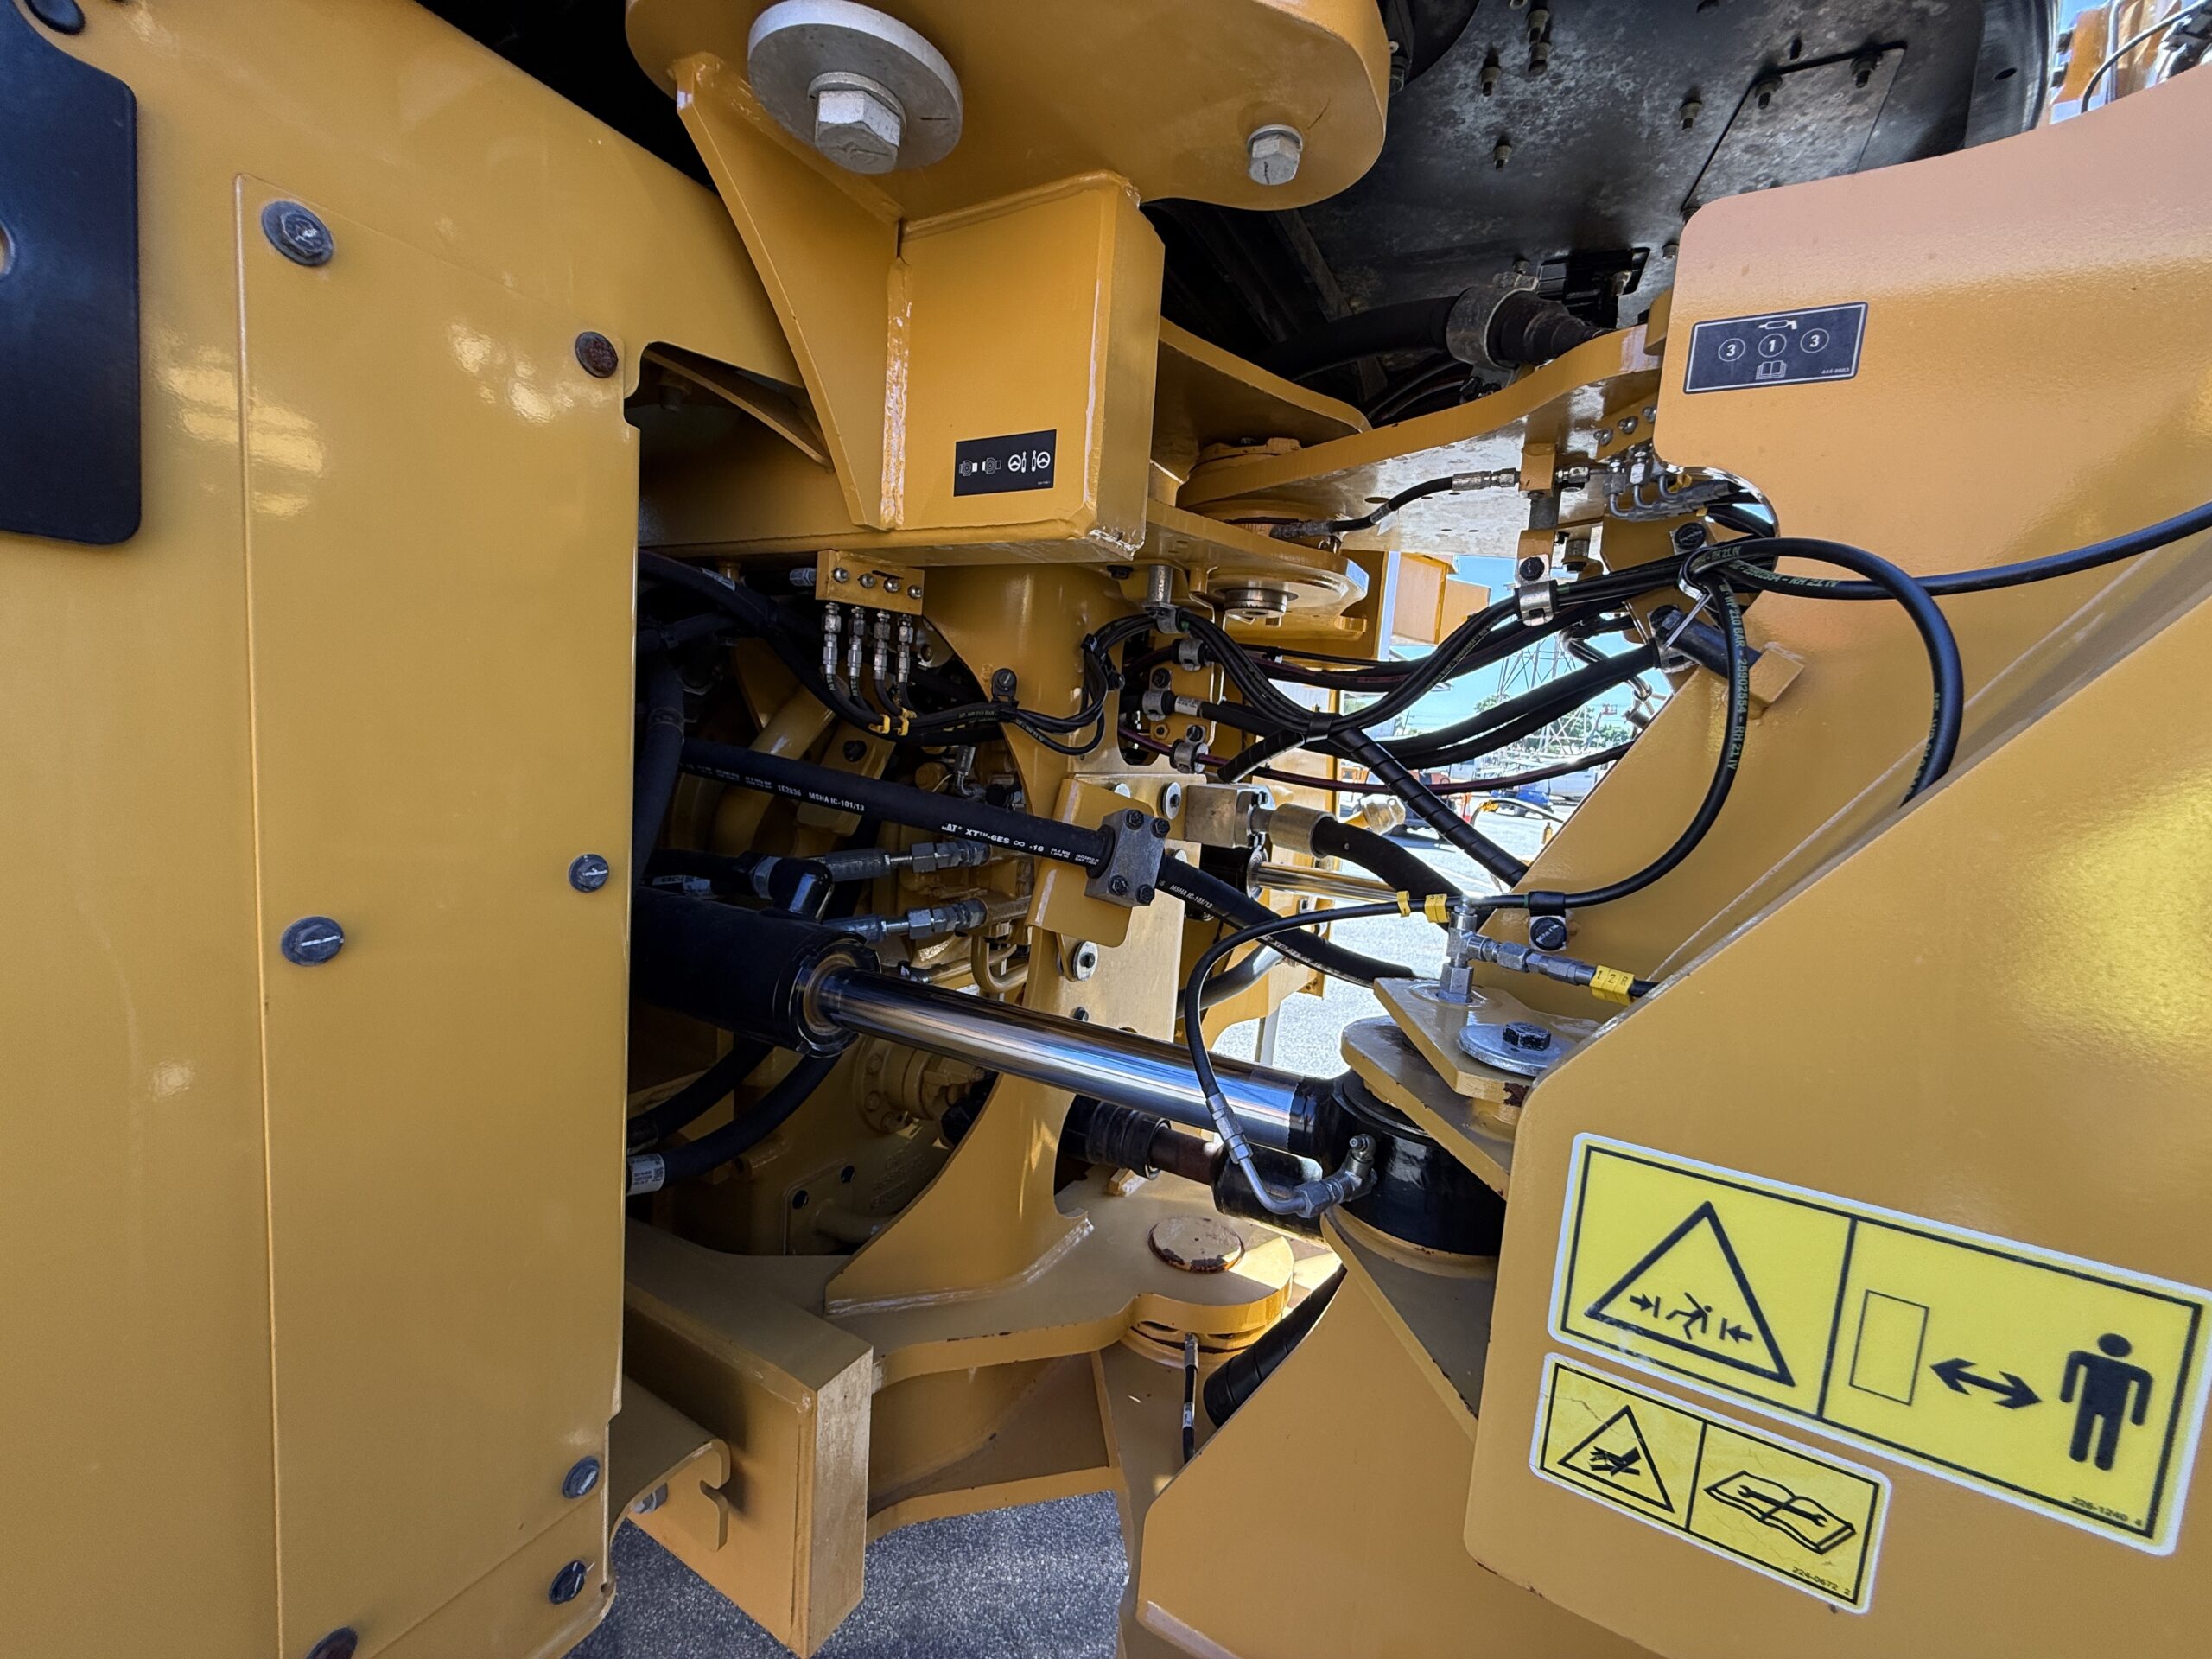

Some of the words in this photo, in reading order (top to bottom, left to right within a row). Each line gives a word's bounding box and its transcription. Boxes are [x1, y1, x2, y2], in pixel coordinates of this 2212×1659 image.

[1726, 344, 1736, 357] 3
[1769, 340, 1776, 352] 1
[1809, 334, 1820, 347] 3
[1729, 609, 1742, 626] 210
[1733, 627, 1745, 647] BAR
[1738, 658, 1747, 714] 25902554
[1732, 726, 1745, 741] RH
[1729, 743, 1742, 758] 21
[1726, 760, 1738, 770] IV
[809, 791, 830, 804] MSHA
[830, 798, 864, 811] IC-101/13
[1169, 884, 1188, 896] MSHA
[1597, 970, 1603, 980] 1
[1608, 973, 1616, 984] 2
[1621, 976, 1629, 986] R
